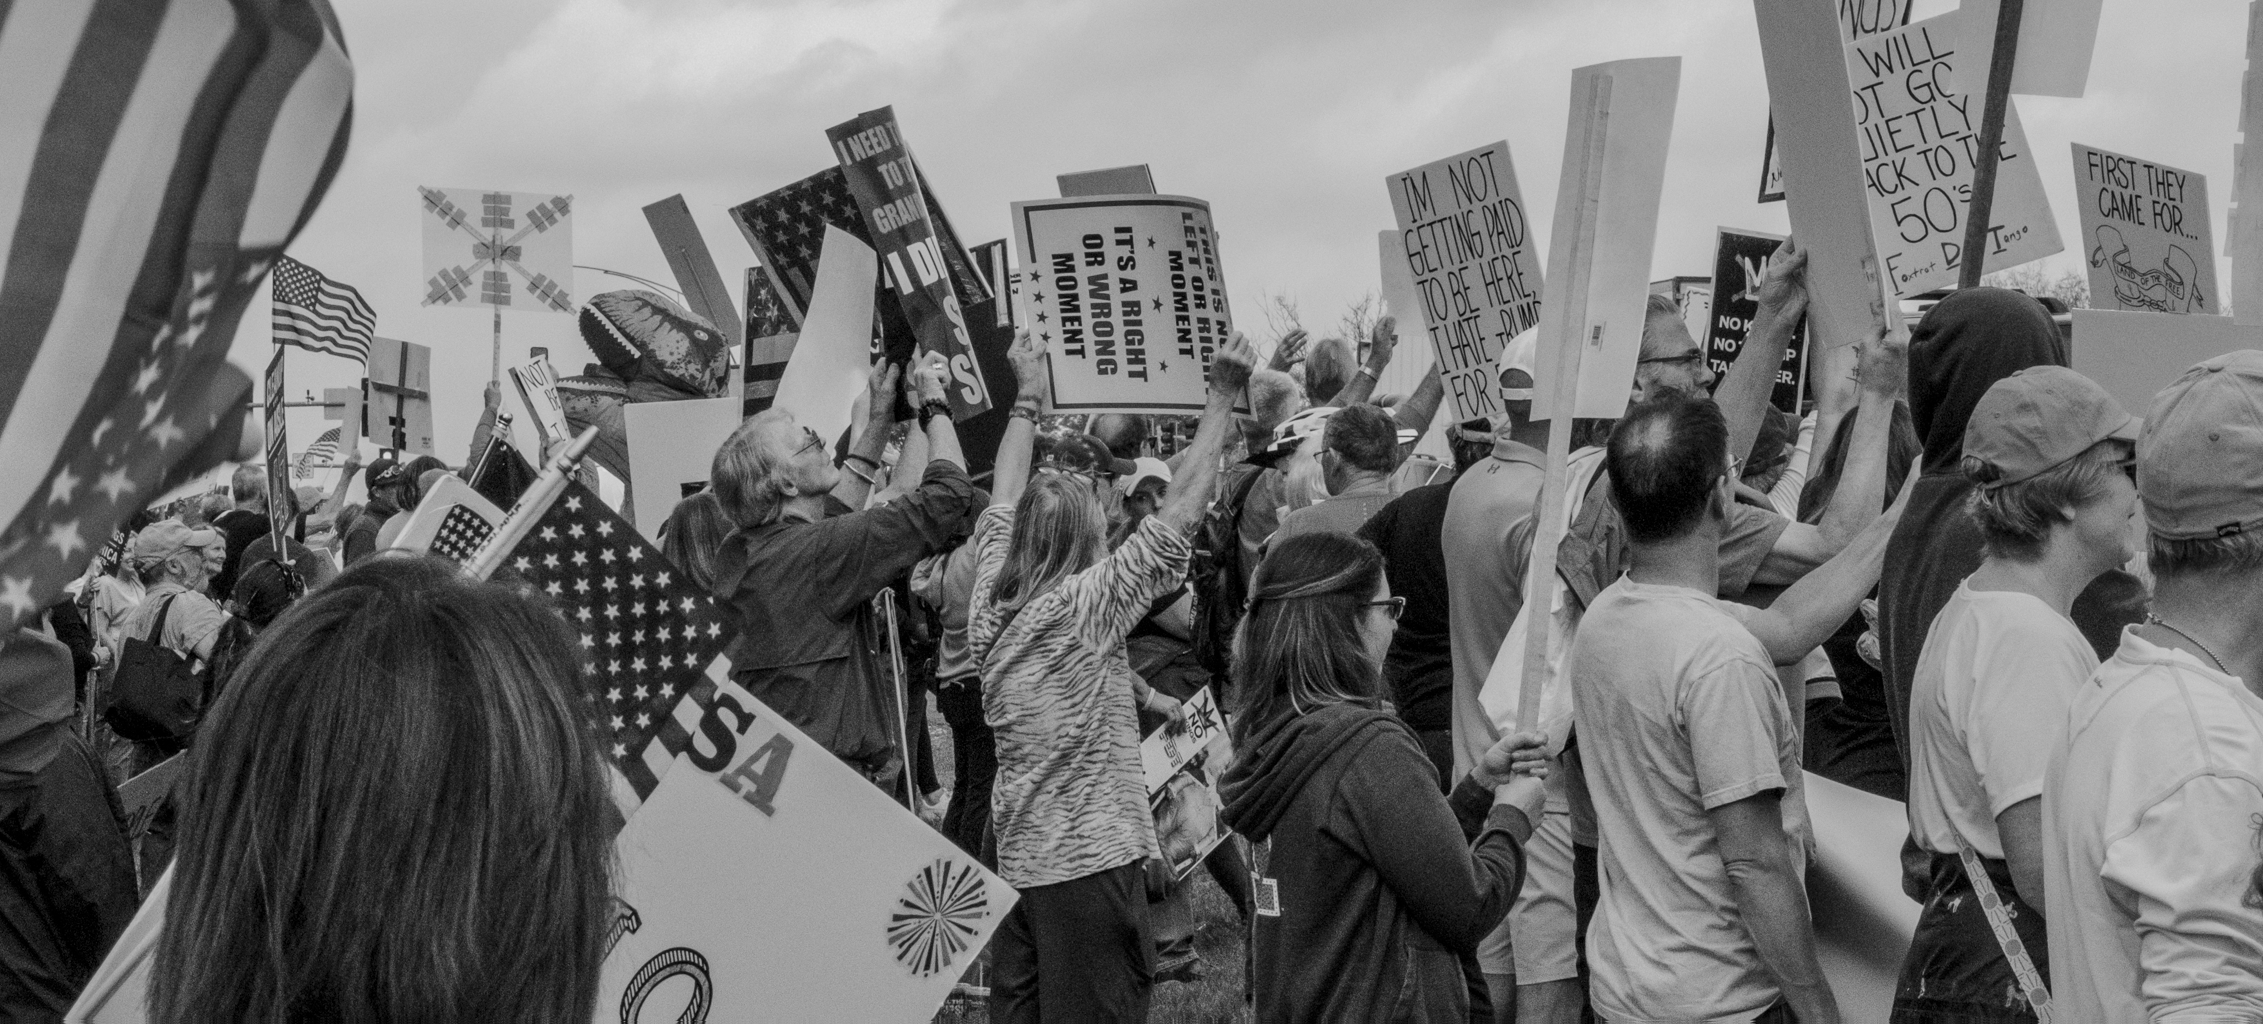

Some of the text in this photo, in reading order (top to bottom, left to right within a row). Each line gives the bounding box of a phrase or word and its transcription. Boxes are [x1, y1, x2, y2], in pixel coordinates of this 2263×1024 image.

[1857, 26, 1954, 78] WILL
[1853, 61, 1955, 125] OT GO
[837, 140, 853, 166] I
[847, 124, 892, 162] NEED
[1864, 94, 1972, 163] UIETLY
[877, 160, 904, 190] TO
[1401, 150, 1500, 224] I'M NOT
[1865, 133, 2017, 197] ACK TO TE
[2088, 151, 2186, 203] FIRST THEY
[1405, 198, 1524, 277] GETTING PAID
[2098, 187, 2198, 240] CAME FOR...
[1181, 212, 1202, 271] LEFT
[887, 251, 914, 295] I
[1191, 275, 1208, 310] OR
[1417, 250, 1536, 324] TO BE HERE,
[1886, 252, 1937, 296] Foxtrot
[2117, 266, 2181, 296] LAND OF THE FREE
[1051, 252, 1087, 359] MOMENT
[1082, 233, 1119, 376] OR WRONG
[1114, 226, 1148, 383] IT'S A RIGHT
[1168, 250, 1195, 359] MOMENT
[1211, 288, 1224, 314] IS
[1719, 315, 1742, 331] NO
[1430, 327, 1451, 375] I
[1444, 315, 1493, 370] HATE
[1714, 337, 1737, 352] NO
[519, 360, 549, 392] NOT
[1451, 368, 1497, 420] FOR
[1188, 712, 1204, 739] NO
[684, 692, 795, 818] SA
